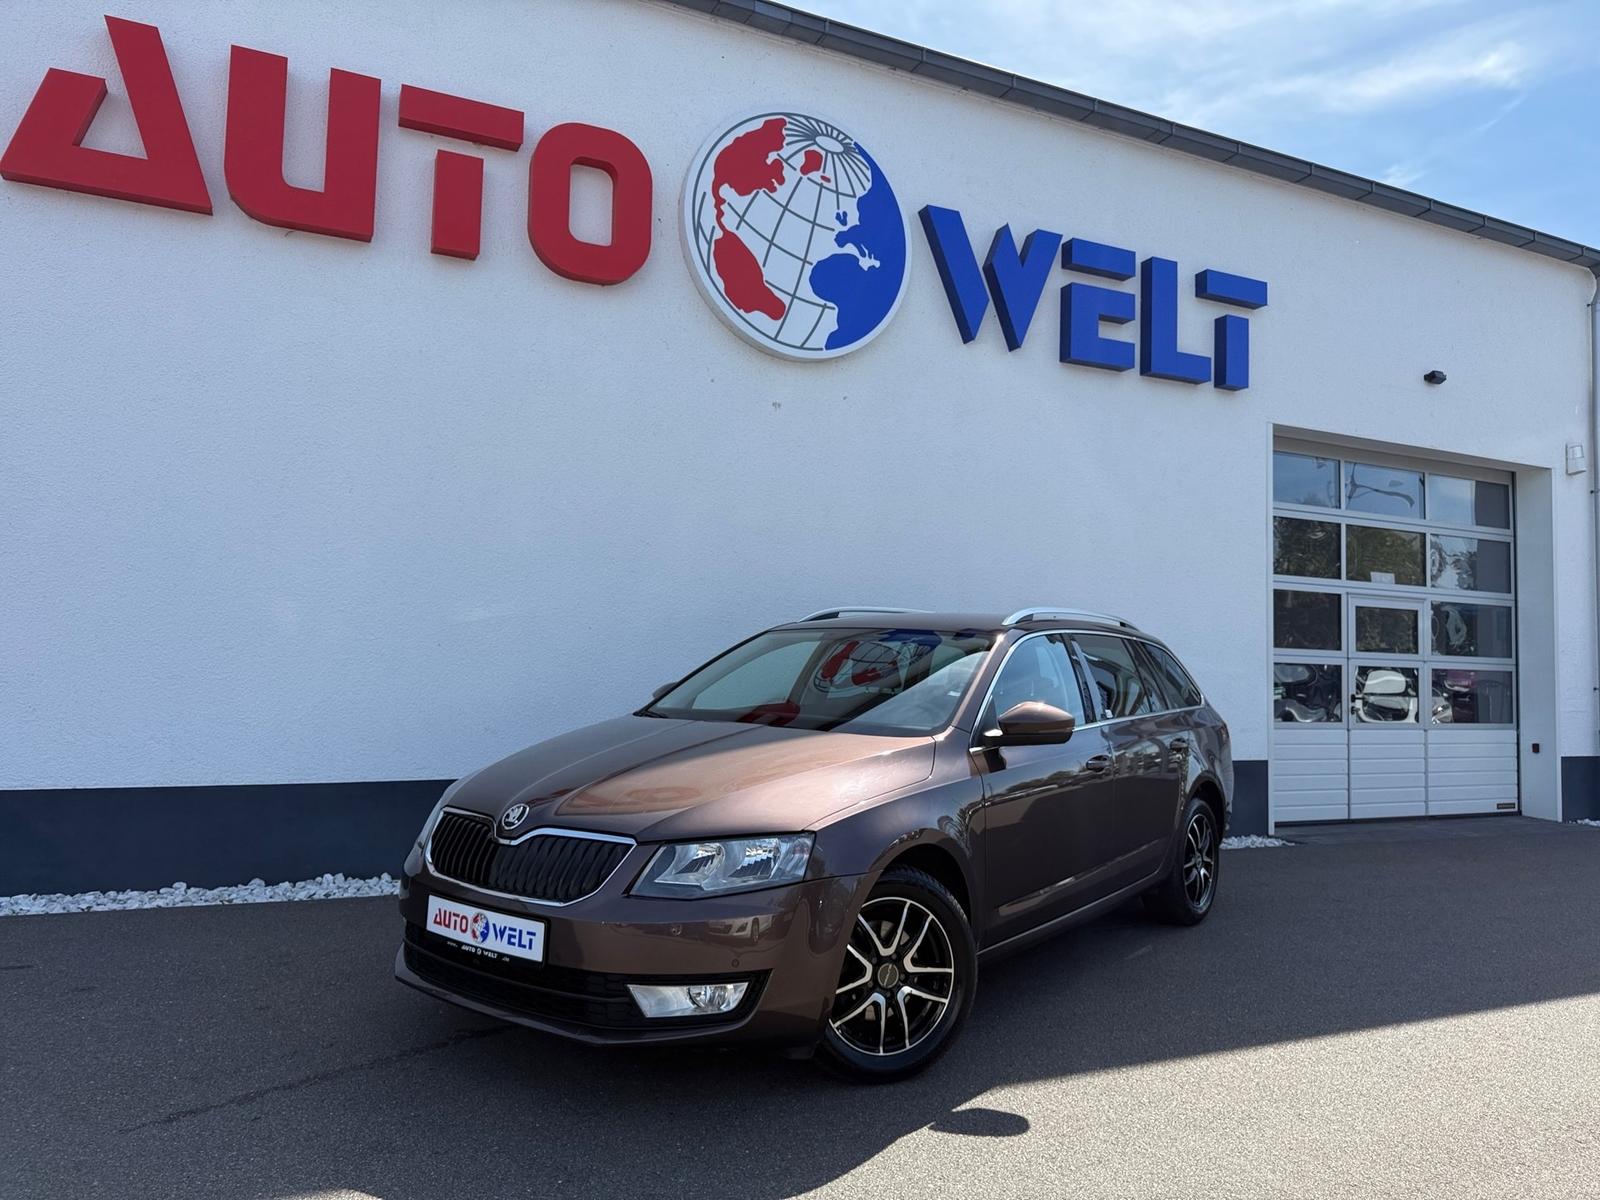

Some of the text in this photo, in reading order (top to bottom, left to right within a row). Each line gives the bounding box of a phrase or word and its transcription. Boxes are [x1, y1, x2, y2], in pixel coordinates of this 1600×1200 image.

[0, 14, 1268, 391] AUTO WELT
[433, 908, 536, 950] AUTO WELT
[461, 945, 476, 953] AUTO
[483, 950, 498, 959] WELT
